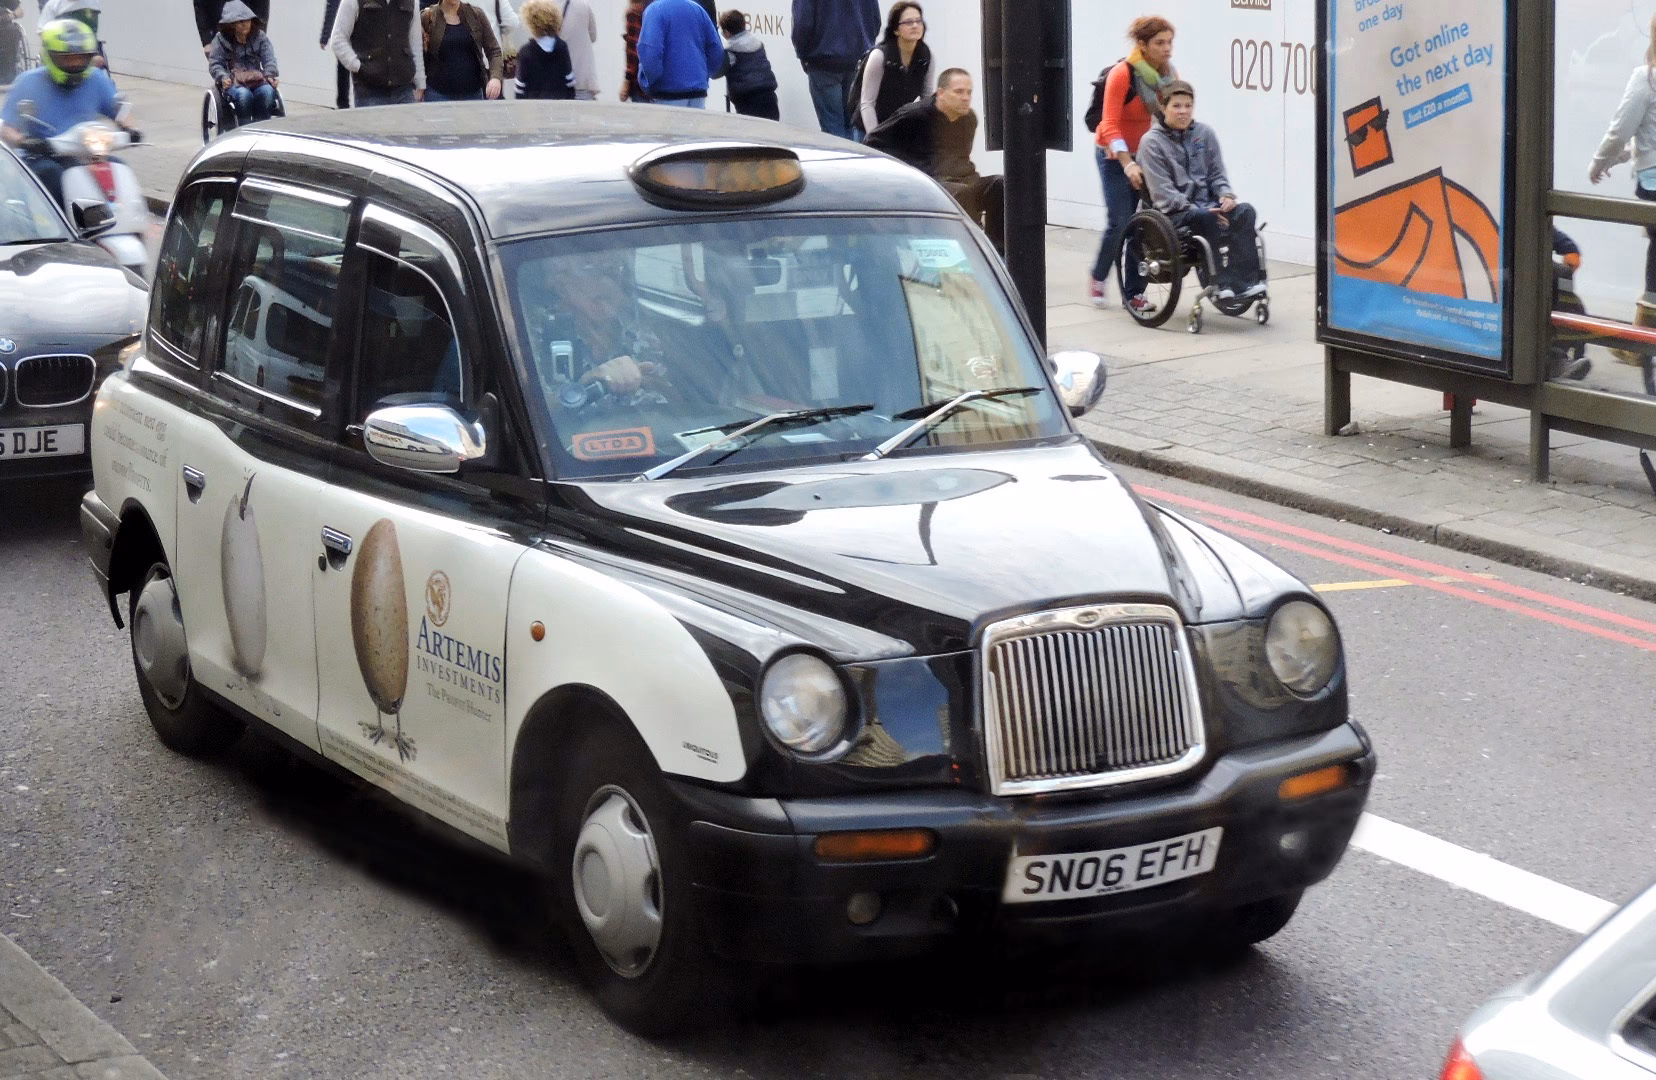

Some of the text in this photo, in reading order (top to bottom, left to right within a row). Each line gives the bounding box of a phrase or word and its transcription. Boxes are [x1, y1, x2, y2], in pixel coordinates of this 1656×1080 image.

[743, 13, 784, 36] BANK
[1358, 4, 1403, 32] one day
[1230, 38, 1273, 92] 020
[1390, 22, 1469, 67] Got online
[1396, 43, 1494, 96] the next day
[12, 430, 59, 455] DJE
[588, 438, 638, 451] LTDA
[416, 615, 501, 684] ARTEMIS
[416, 654, 500, 704] INVESTMENTS
[1022, 835, 1206, 895] SN06 EFH
